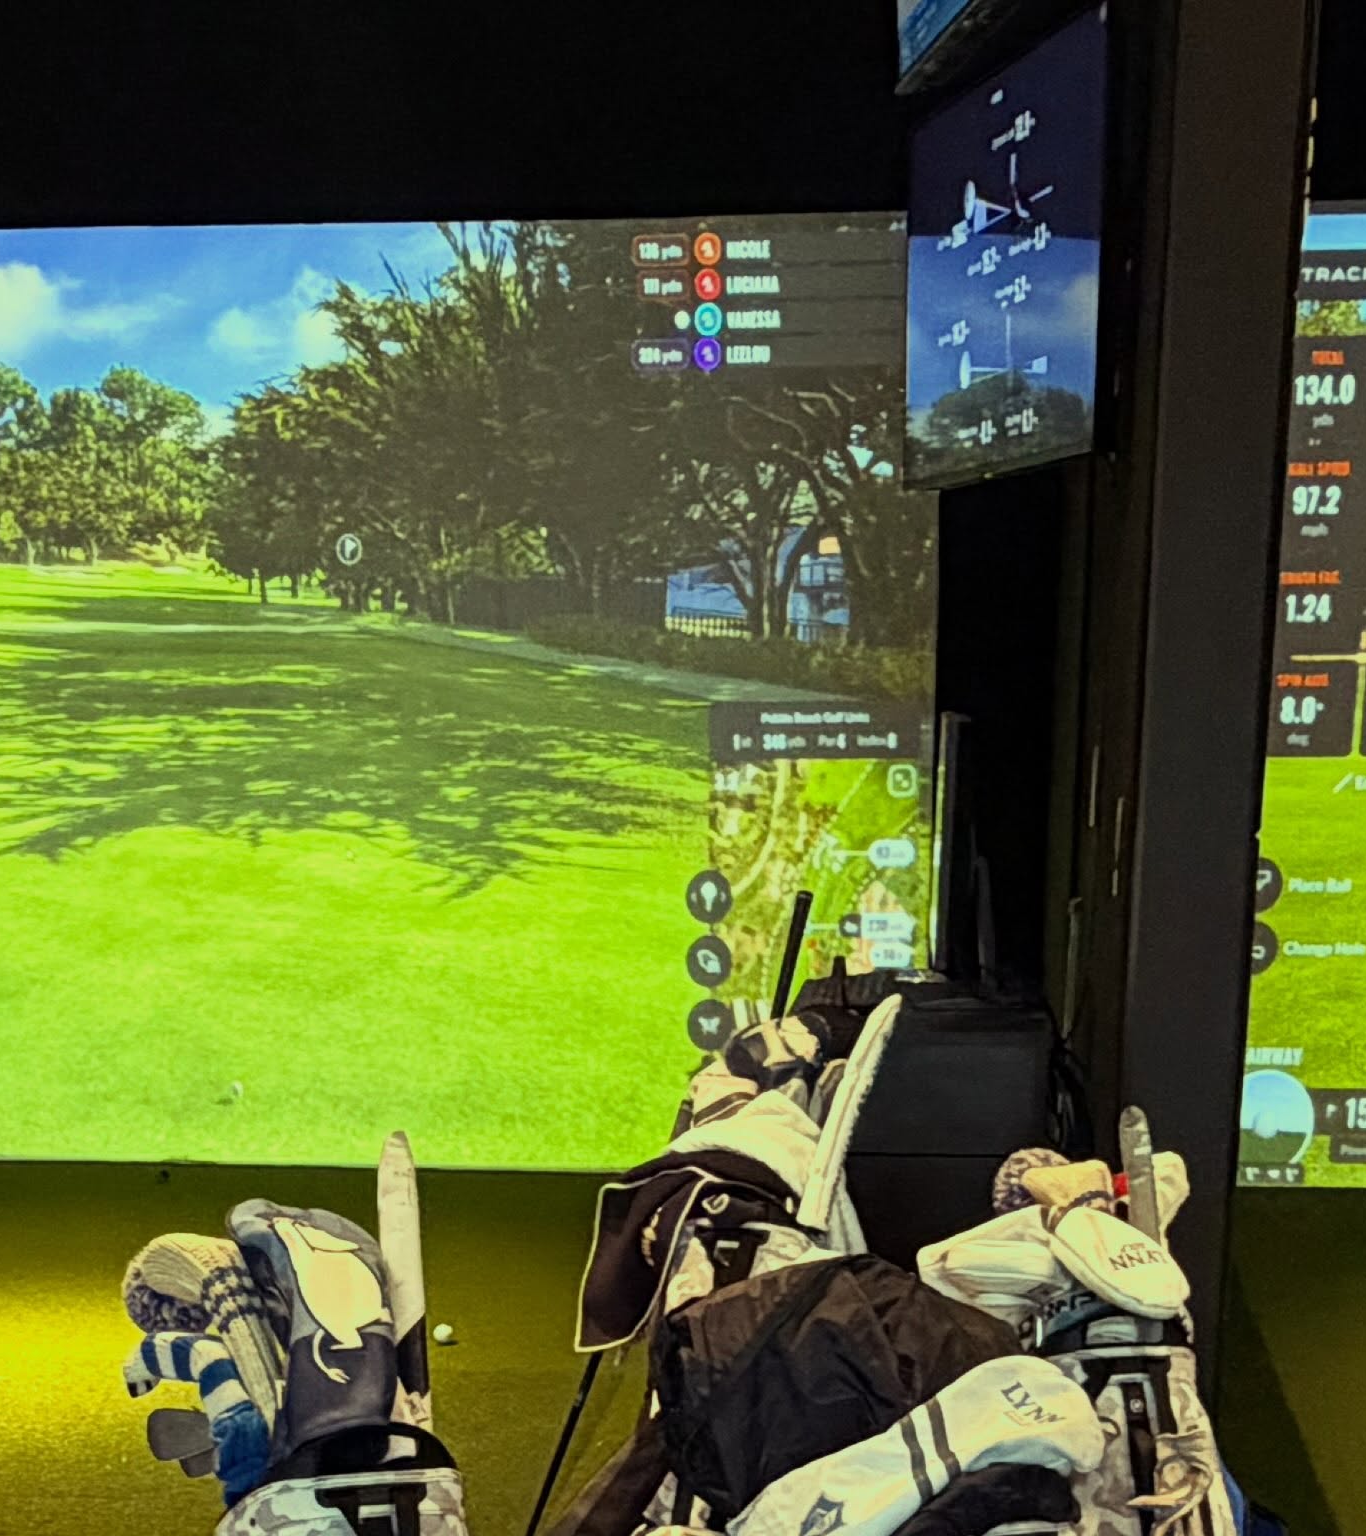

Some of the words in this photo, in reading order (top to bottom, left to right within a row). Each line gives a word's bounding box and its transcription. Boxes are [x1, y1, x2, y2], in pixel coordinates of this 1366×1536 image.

[1295, 374, 1356, 405] 134.0
[1292, 485, 1343, 515] 97.2
[1285, 593, 1332, 623] 1.24
[1001, 1382, 1067, 1424] LYNN
